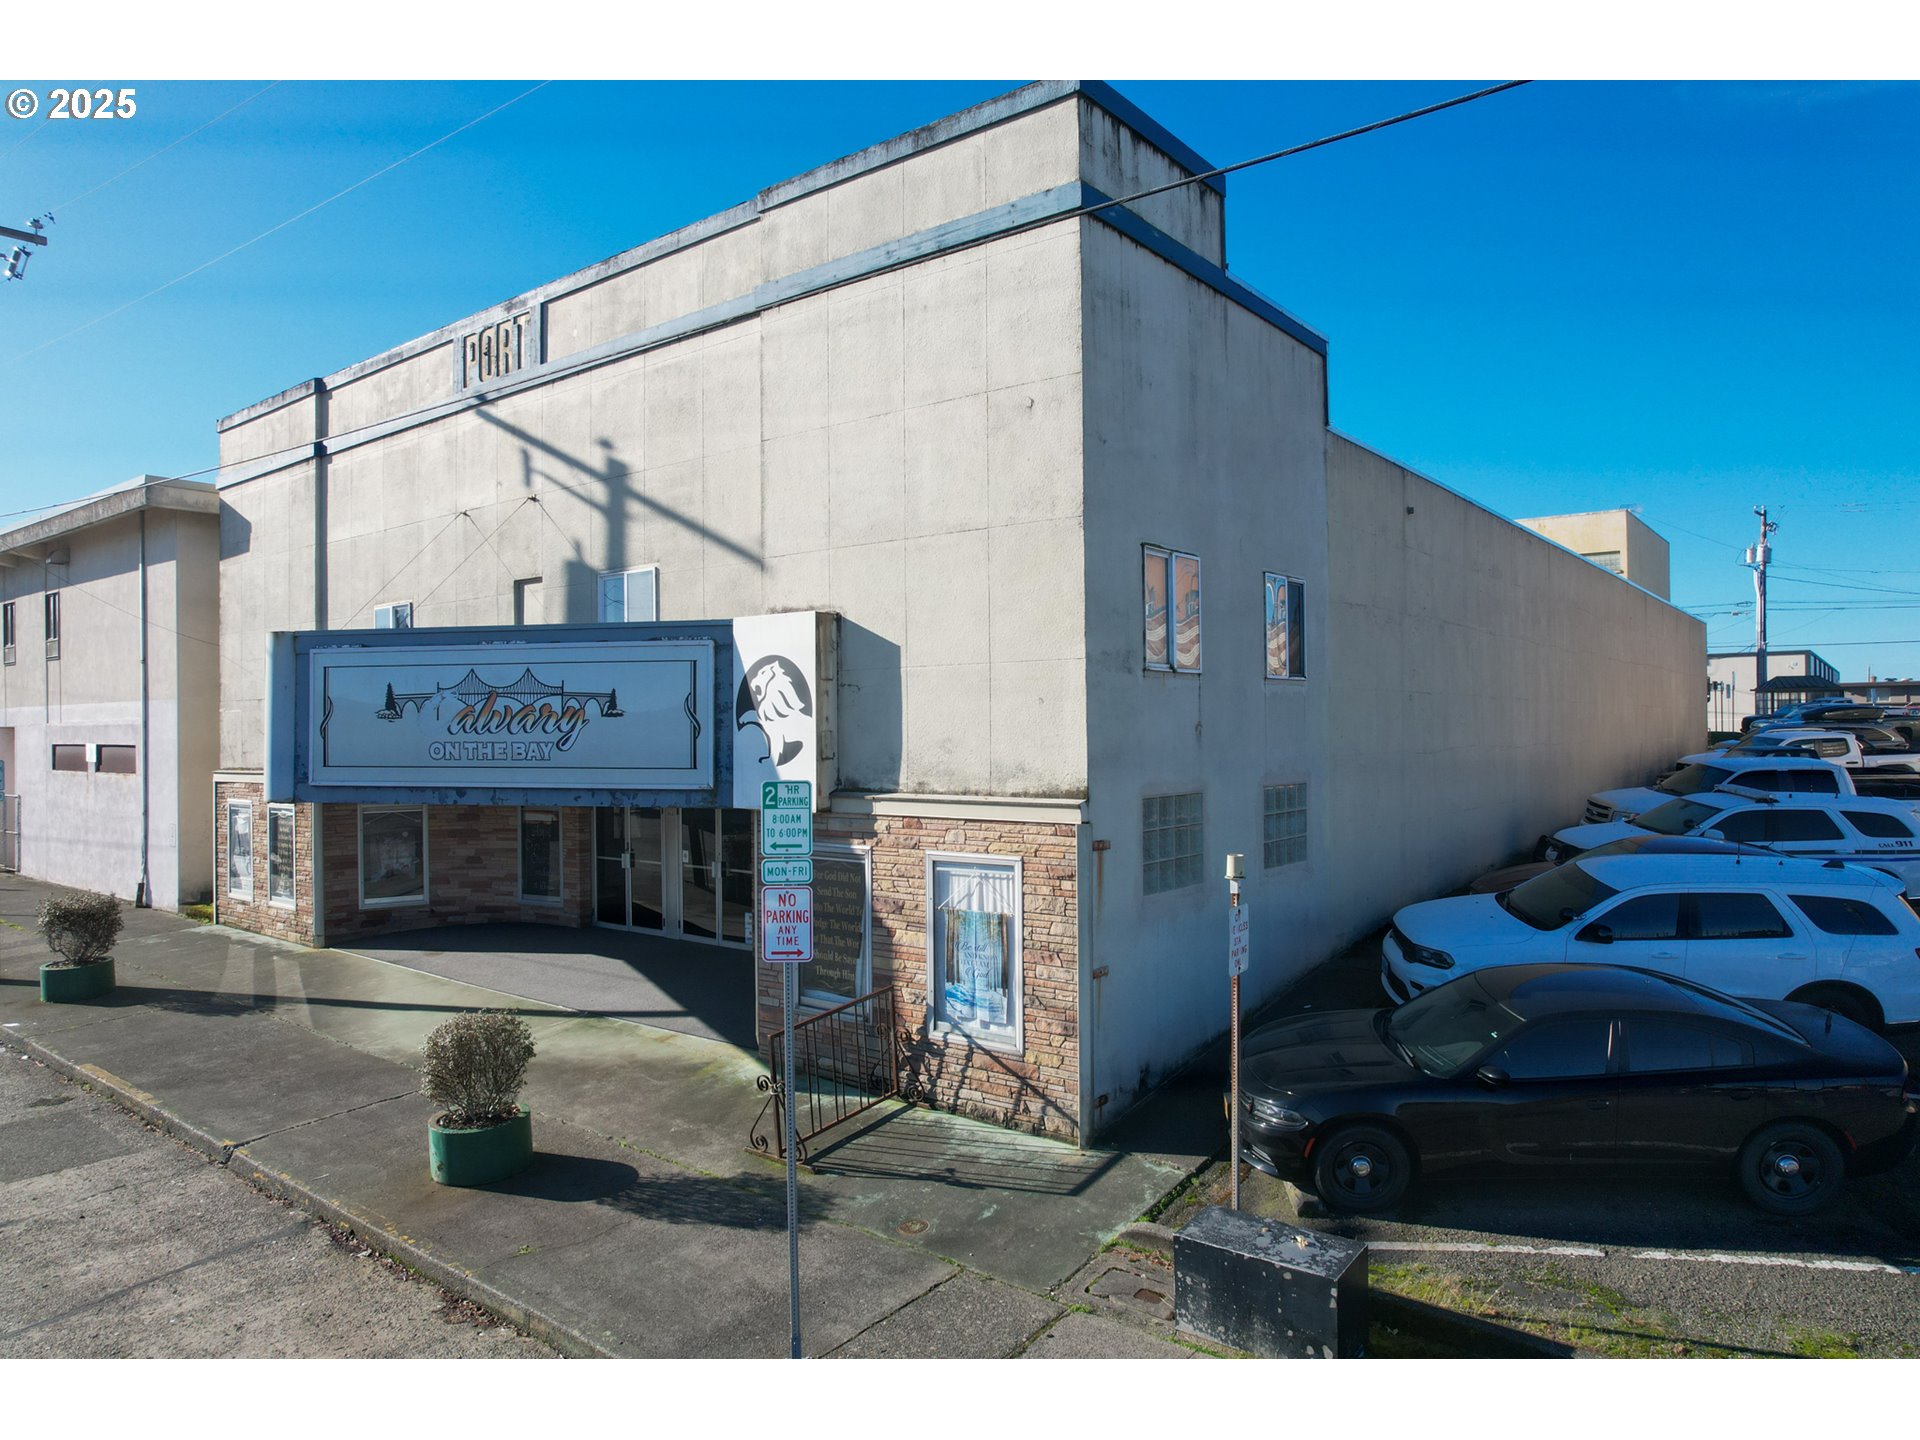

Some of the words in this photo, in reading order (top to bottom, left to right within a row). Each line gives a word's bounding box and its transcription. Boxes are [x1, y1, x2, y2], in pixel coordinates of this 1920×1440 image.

[462, 310, 531, 389] PORT
[446, 690, 590, 752] alvary
[428, 741, 461, 761] ON
[463, 741, 508, 761] THE
[510, 741, 555, 761] BAY
[786, 784, 800, 795] HR
[765, 786, 776, 805] 2
[778, 796, 809, 807] PARKING
[772, 814, 802, 824] 8:00AM
[766, 828, 776, 838] TO
[779, 828, 808, 838] 6:00PM
[1895, 840, 1914, 848] 911
[767, 866, 808, 877] MON-FRI
[824, 870, 836, 881] God
[837, 871, 849, 882] Did
[832, 887, 844, 898] The
[778, 893, 797, 907] NO
[766, 909, 809, 924] PARKING
[778, 925, 797, 935] ANY
[776, 936, 800, 946] TIME
